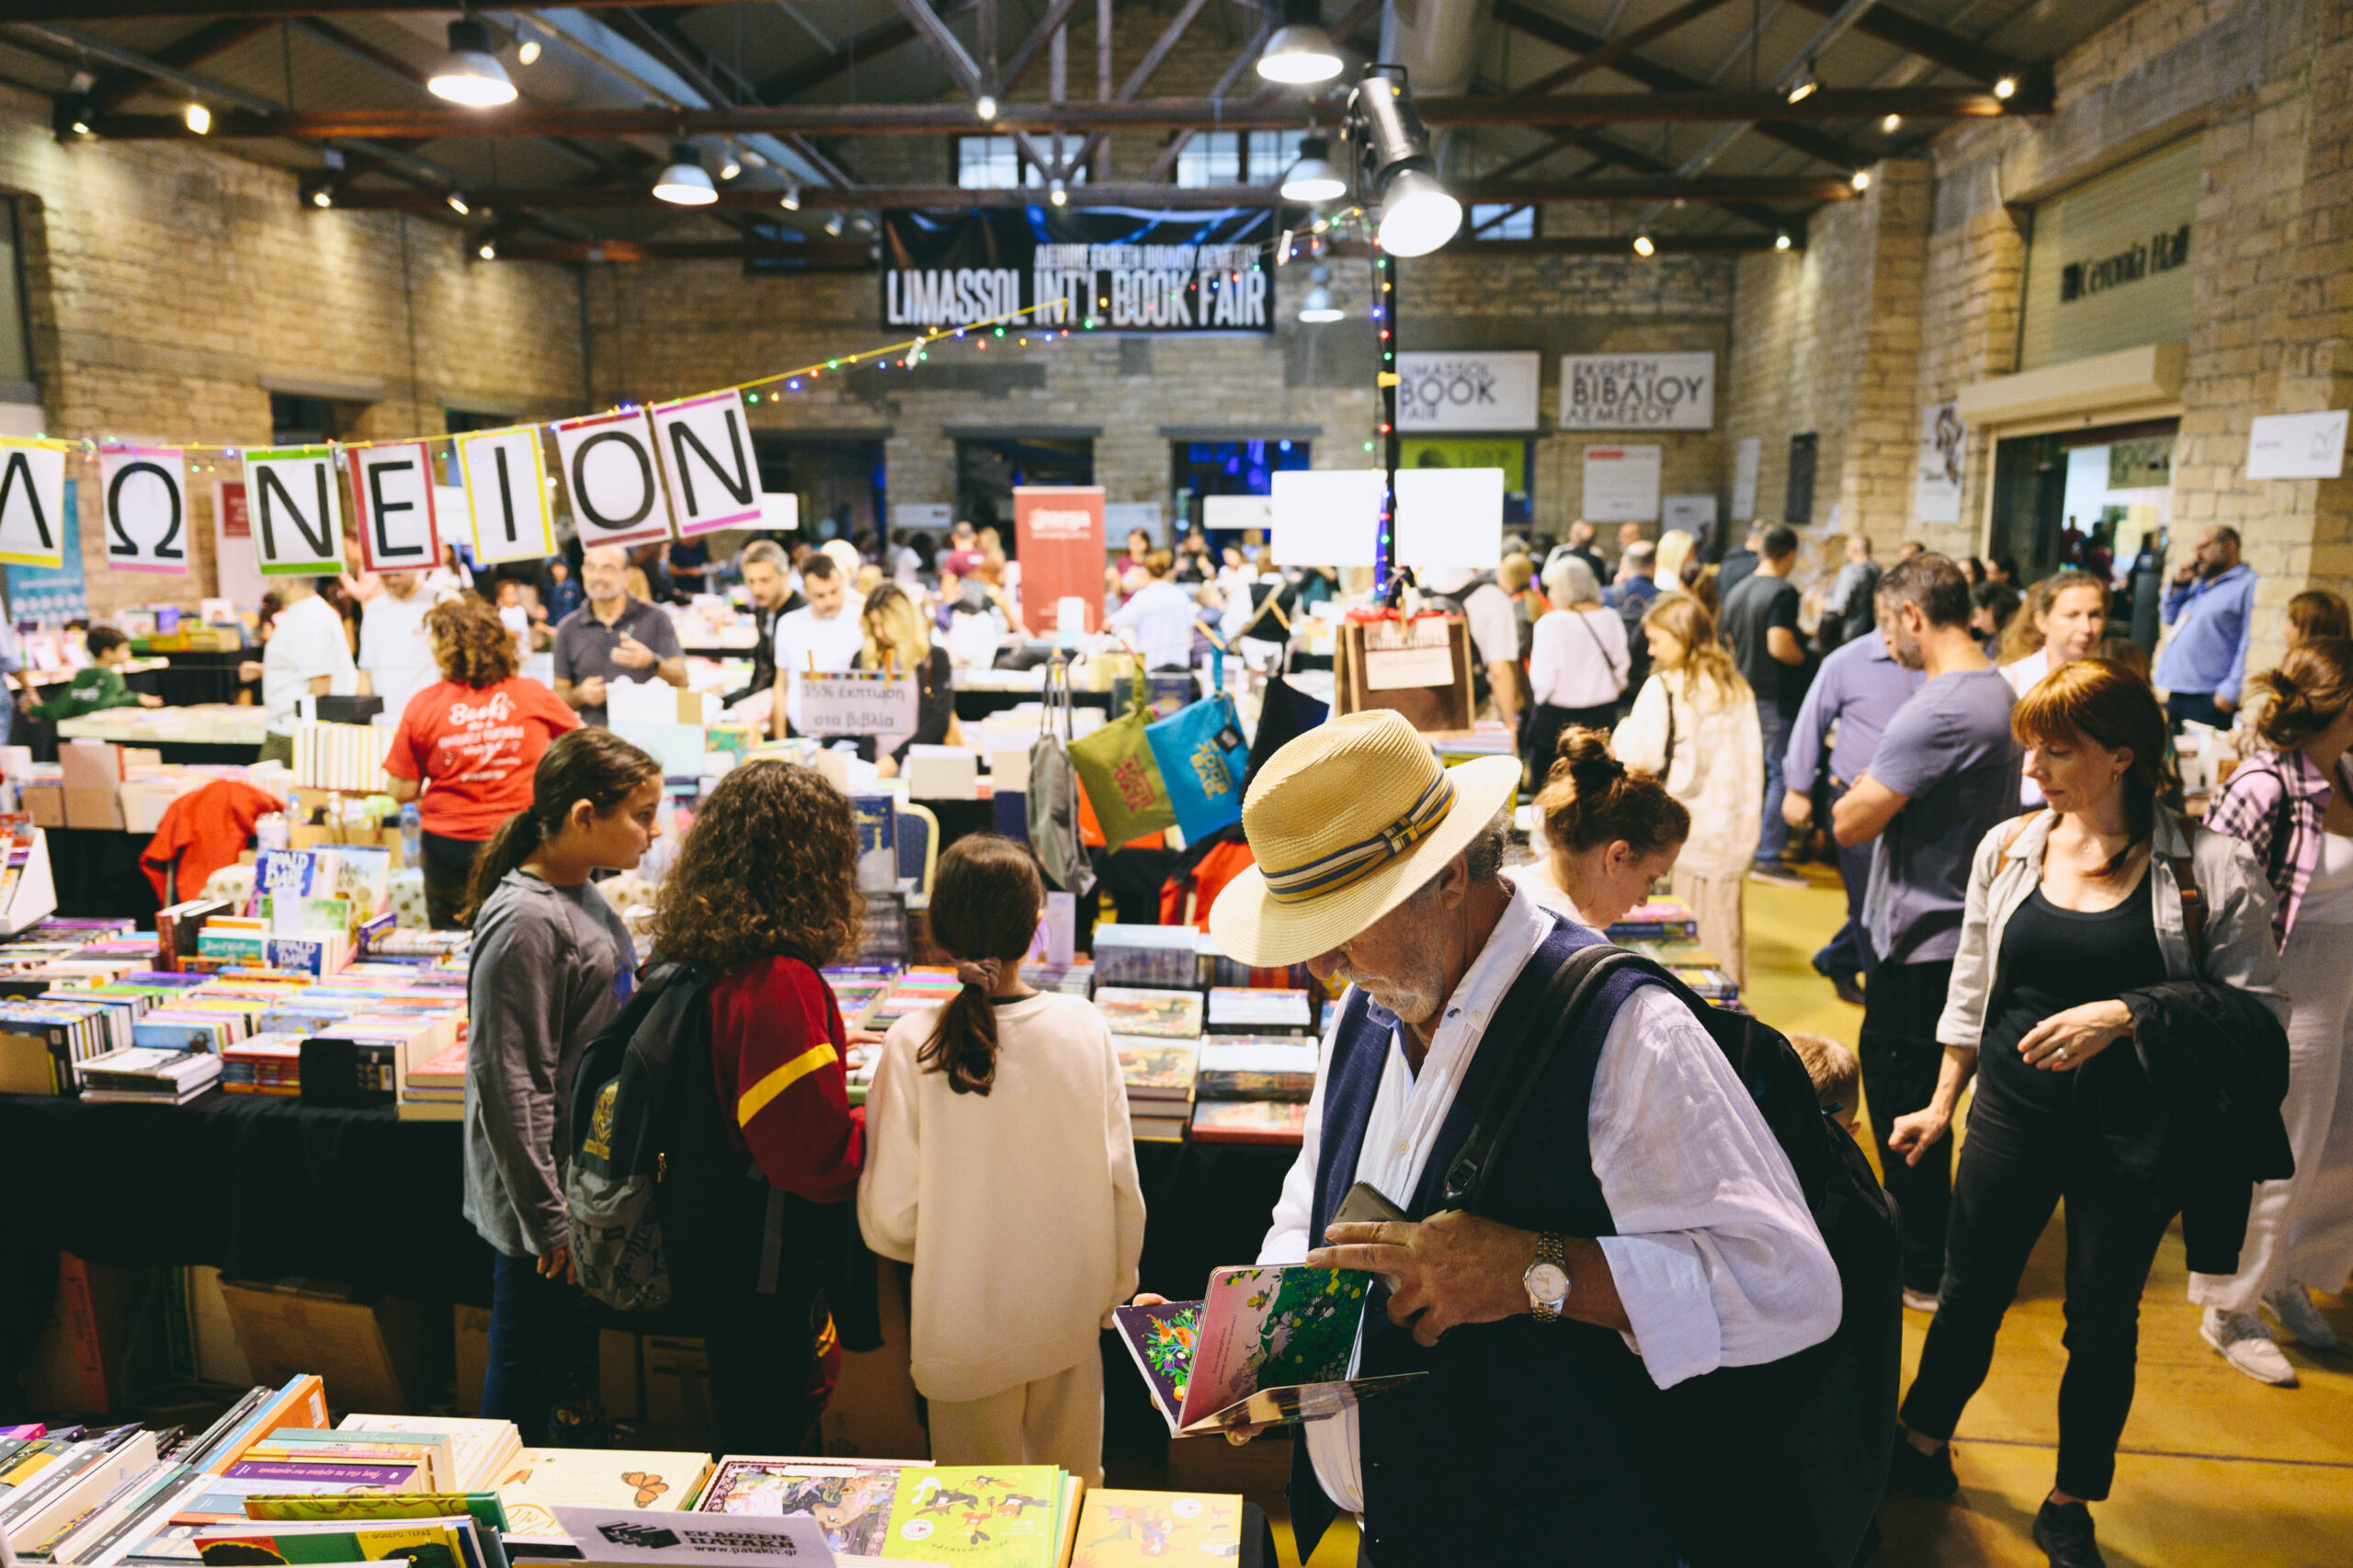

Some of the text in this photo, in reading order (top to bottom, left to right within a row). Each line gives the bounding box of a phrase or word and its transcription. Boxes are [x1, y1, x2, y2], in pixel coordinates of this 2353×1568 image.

[887, 267, 1267, 327] LIMASSOL INT'L BOOK FAIR
[1400, 377, 1497, 406] BOOK
[1573, 376, 1704, 406] ΒΙΒΛΙΟΥ
[267, 851, 309, 871] ROALD
[265, 865, 305, 889] DAHL
[689, 1538, 796, 1550] ΠΑΤΑΚΗ
[694, 1544, 799, 1557] www.patakis.gr
